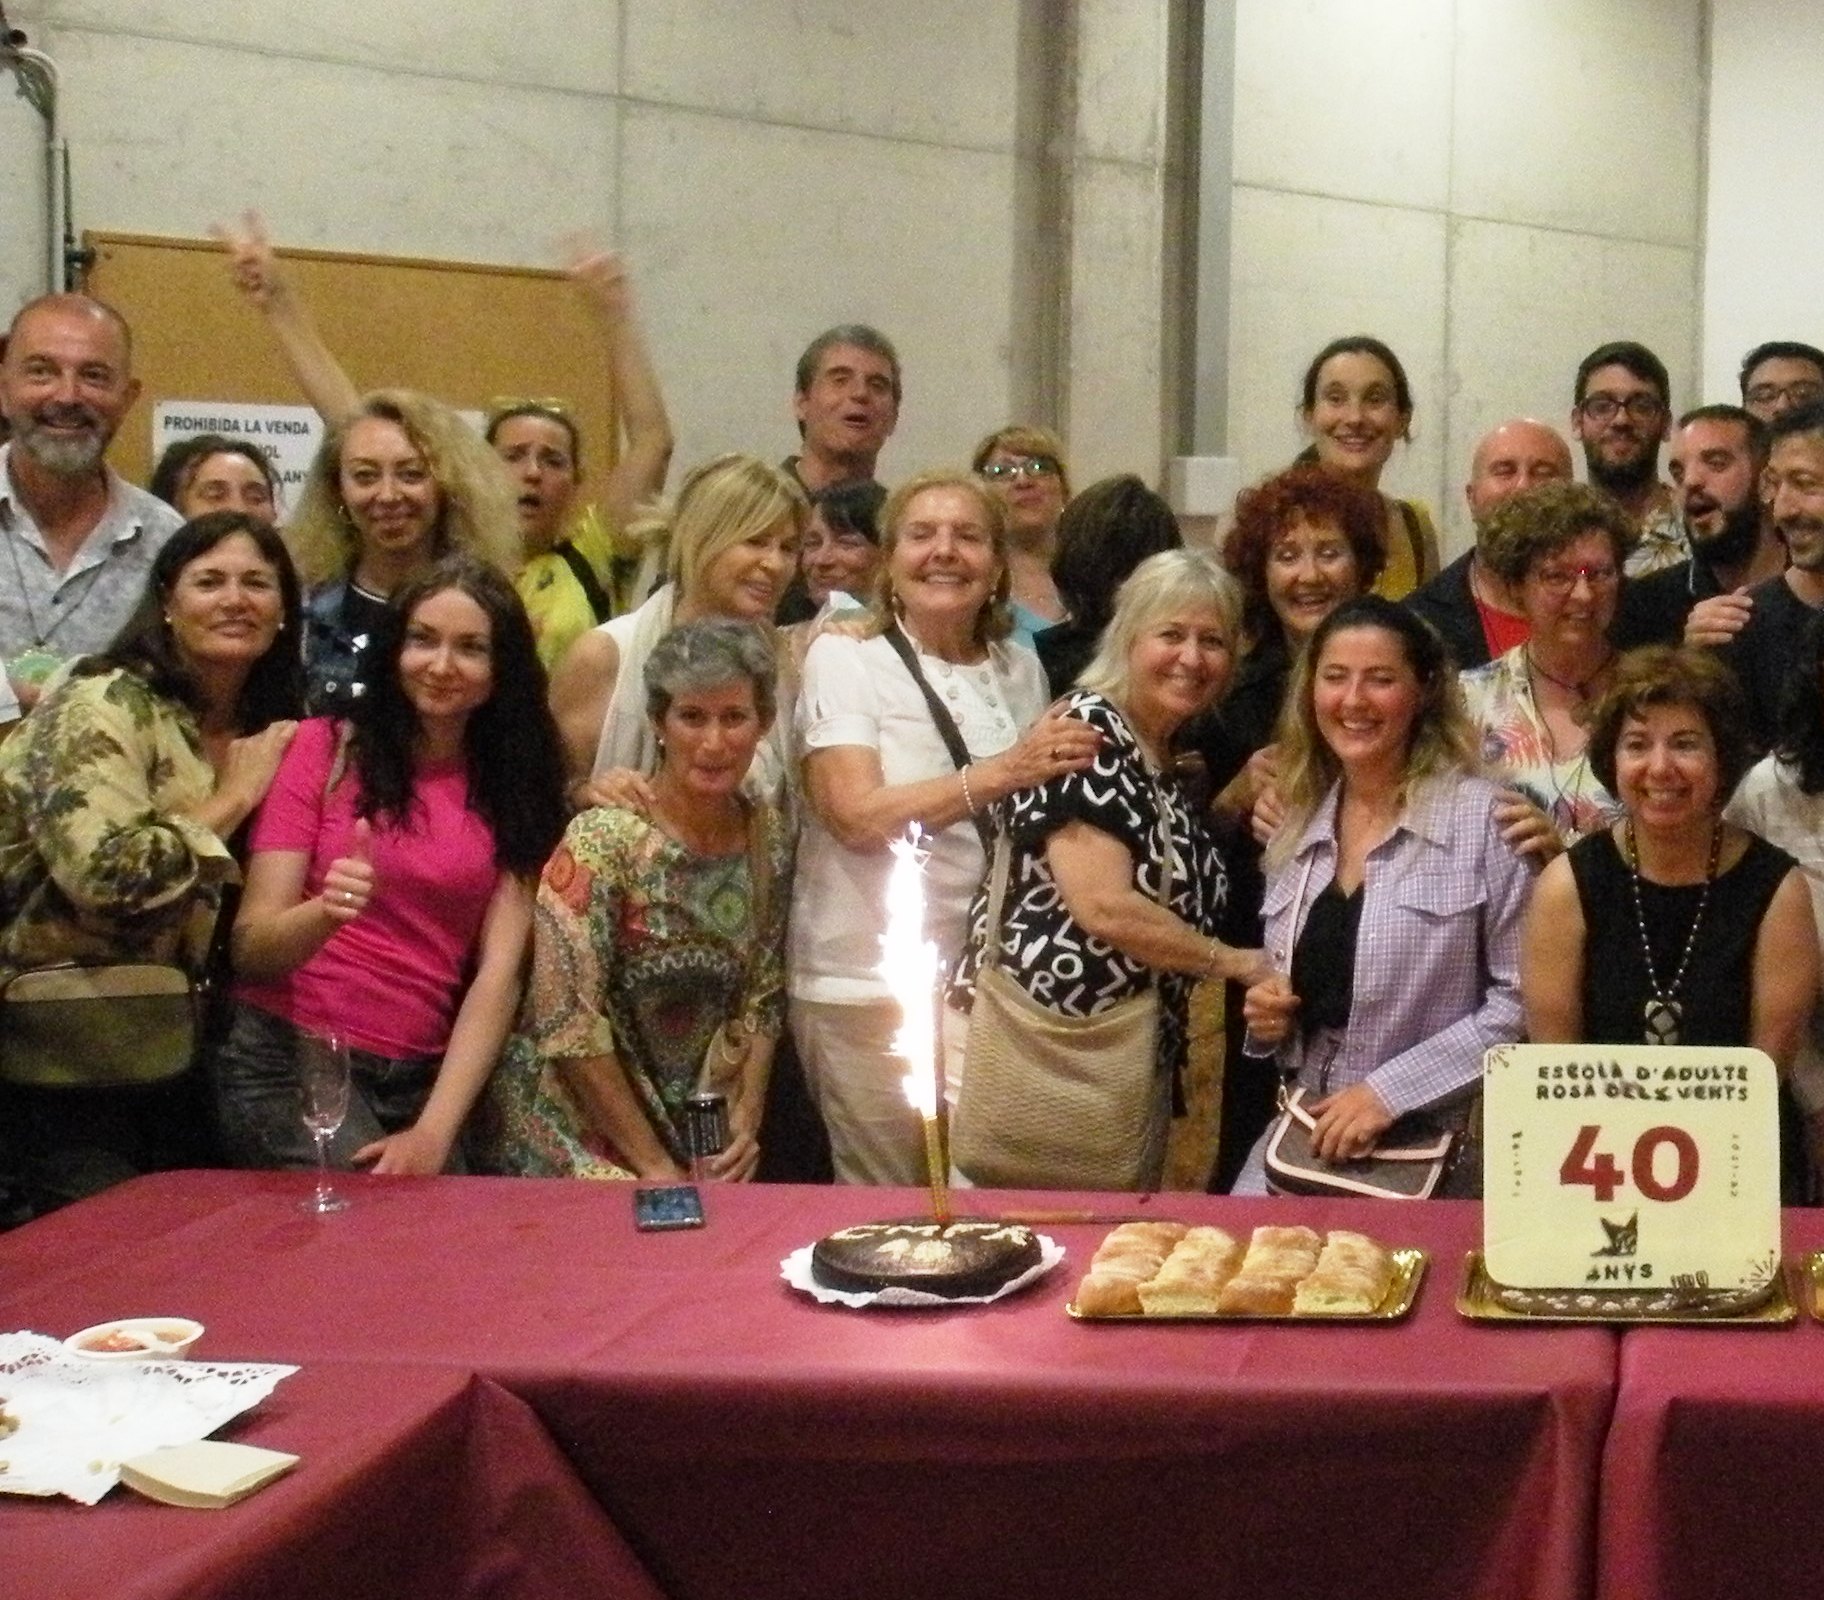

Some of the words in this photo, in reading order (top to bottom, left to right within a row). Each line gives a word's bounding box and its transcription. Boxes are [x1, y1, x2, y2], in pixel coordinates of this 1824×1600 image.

[164, 416, 241, 433] PROHIBIDA
[244, 419, 262, 434] LA
[265, 420, 310, 435] VENDA
[1538, 1062, 1623, 1081] ESCOLA
[1535, 1083, 1597, 1100] ROSA
[1676, 1084, 1748, 1102] VENTS
[1559, 1124, 1700, 1202] 40
[1585, 1262, 1654, 1284] ANYS
